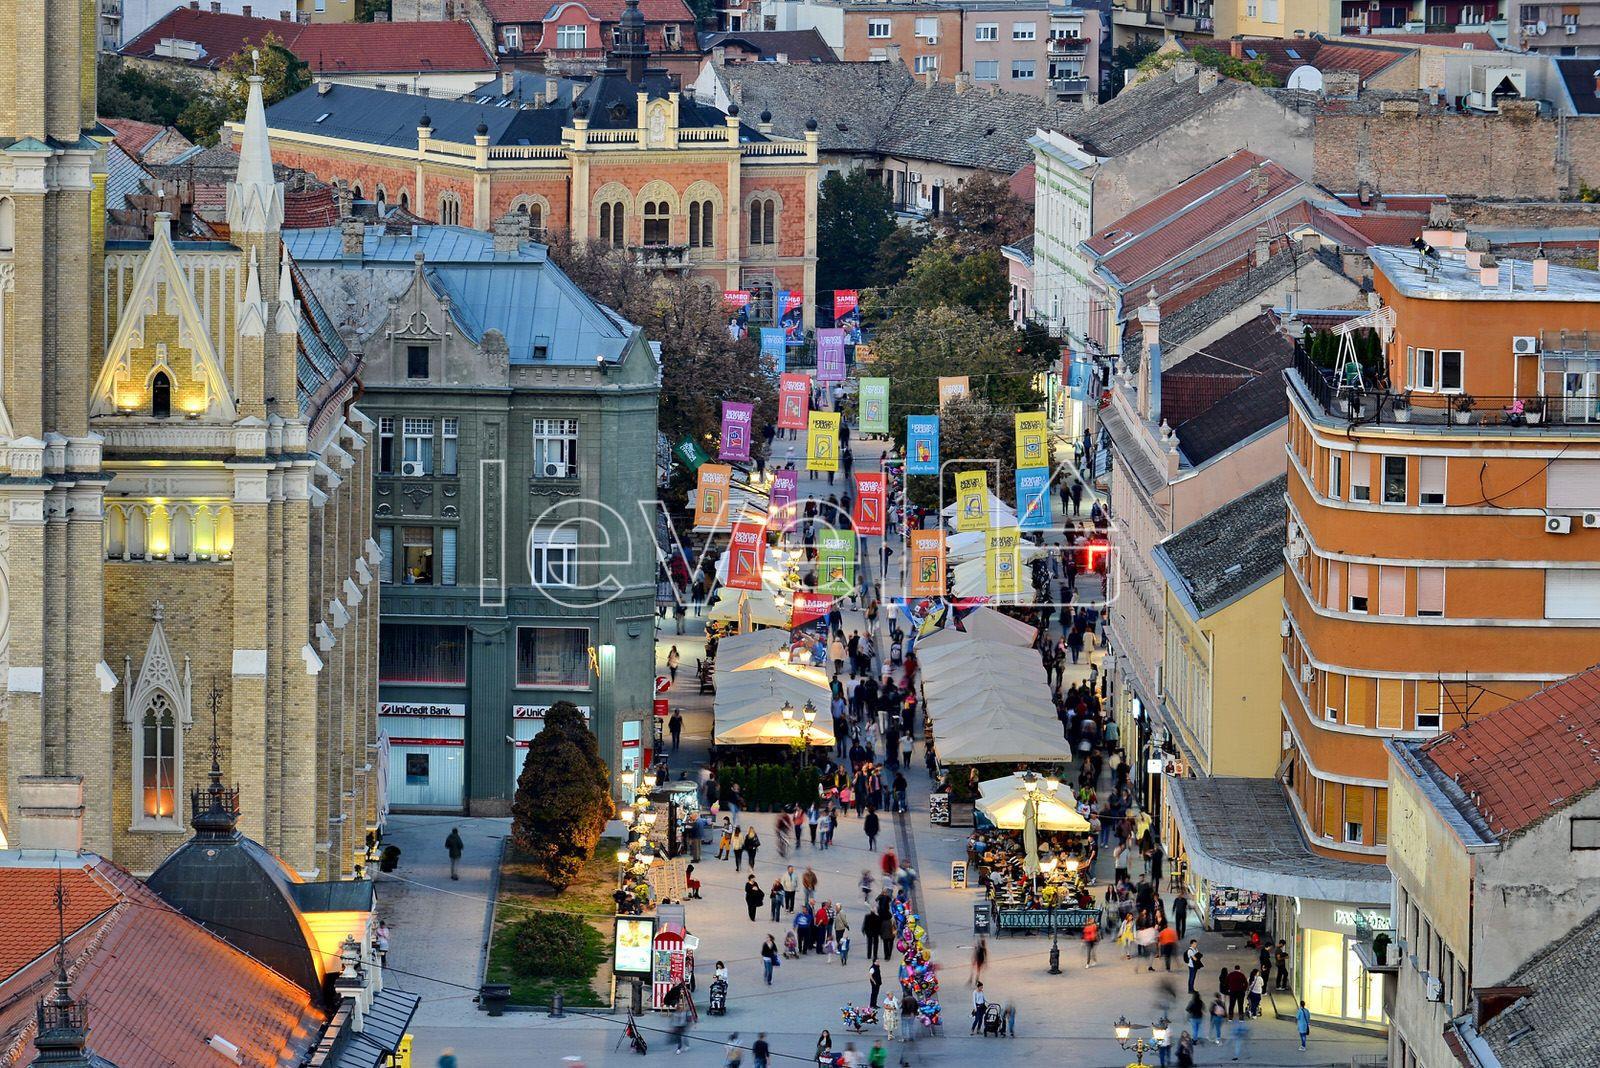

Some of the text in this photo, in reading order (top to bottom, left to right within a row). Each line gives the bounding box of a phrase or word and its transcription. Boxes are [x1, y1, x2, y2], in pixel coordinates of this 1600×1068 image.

[797, 599, 829, 608] AMBO
[392, 704, 450, 715] UniCredit Bank
